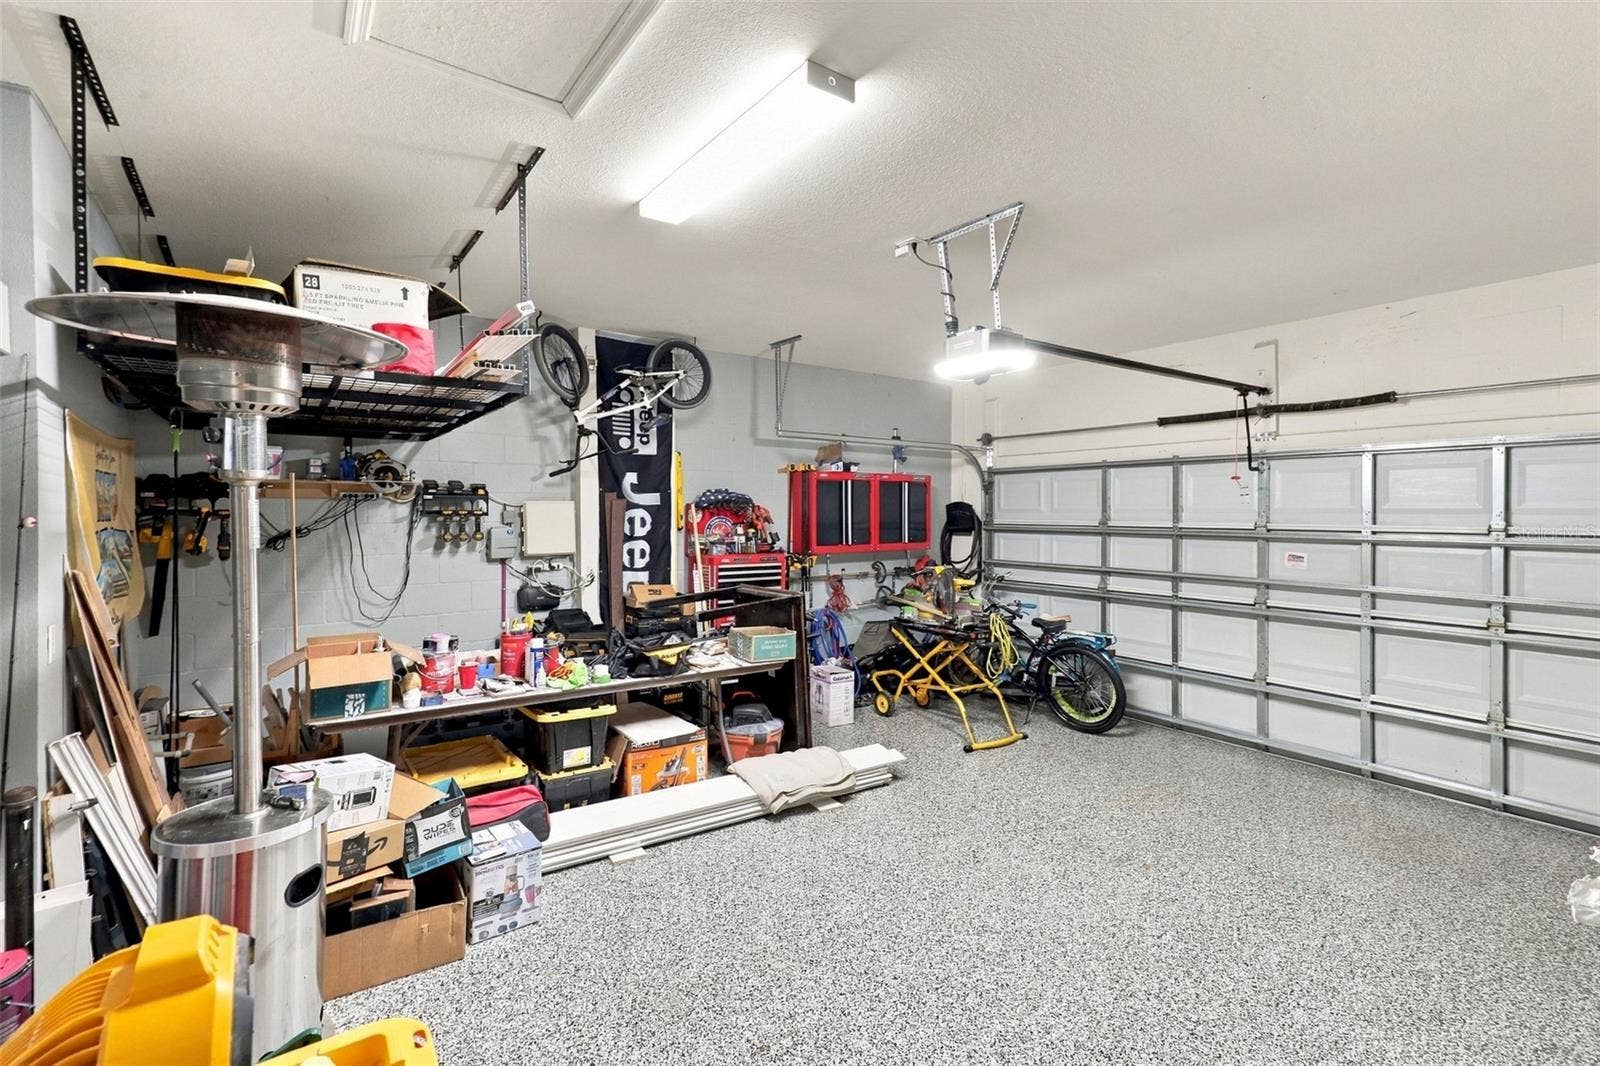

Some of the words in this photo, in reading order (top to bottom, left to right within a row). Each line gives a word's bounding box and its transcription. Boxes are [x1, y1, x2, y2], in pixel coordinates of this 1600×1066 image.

[305, 276, 318, 288] 28
[347, 302, 365, 310] TREE
[422, 819, 454, 836] DUDE
[423, 827, 456, 841] WIPES
